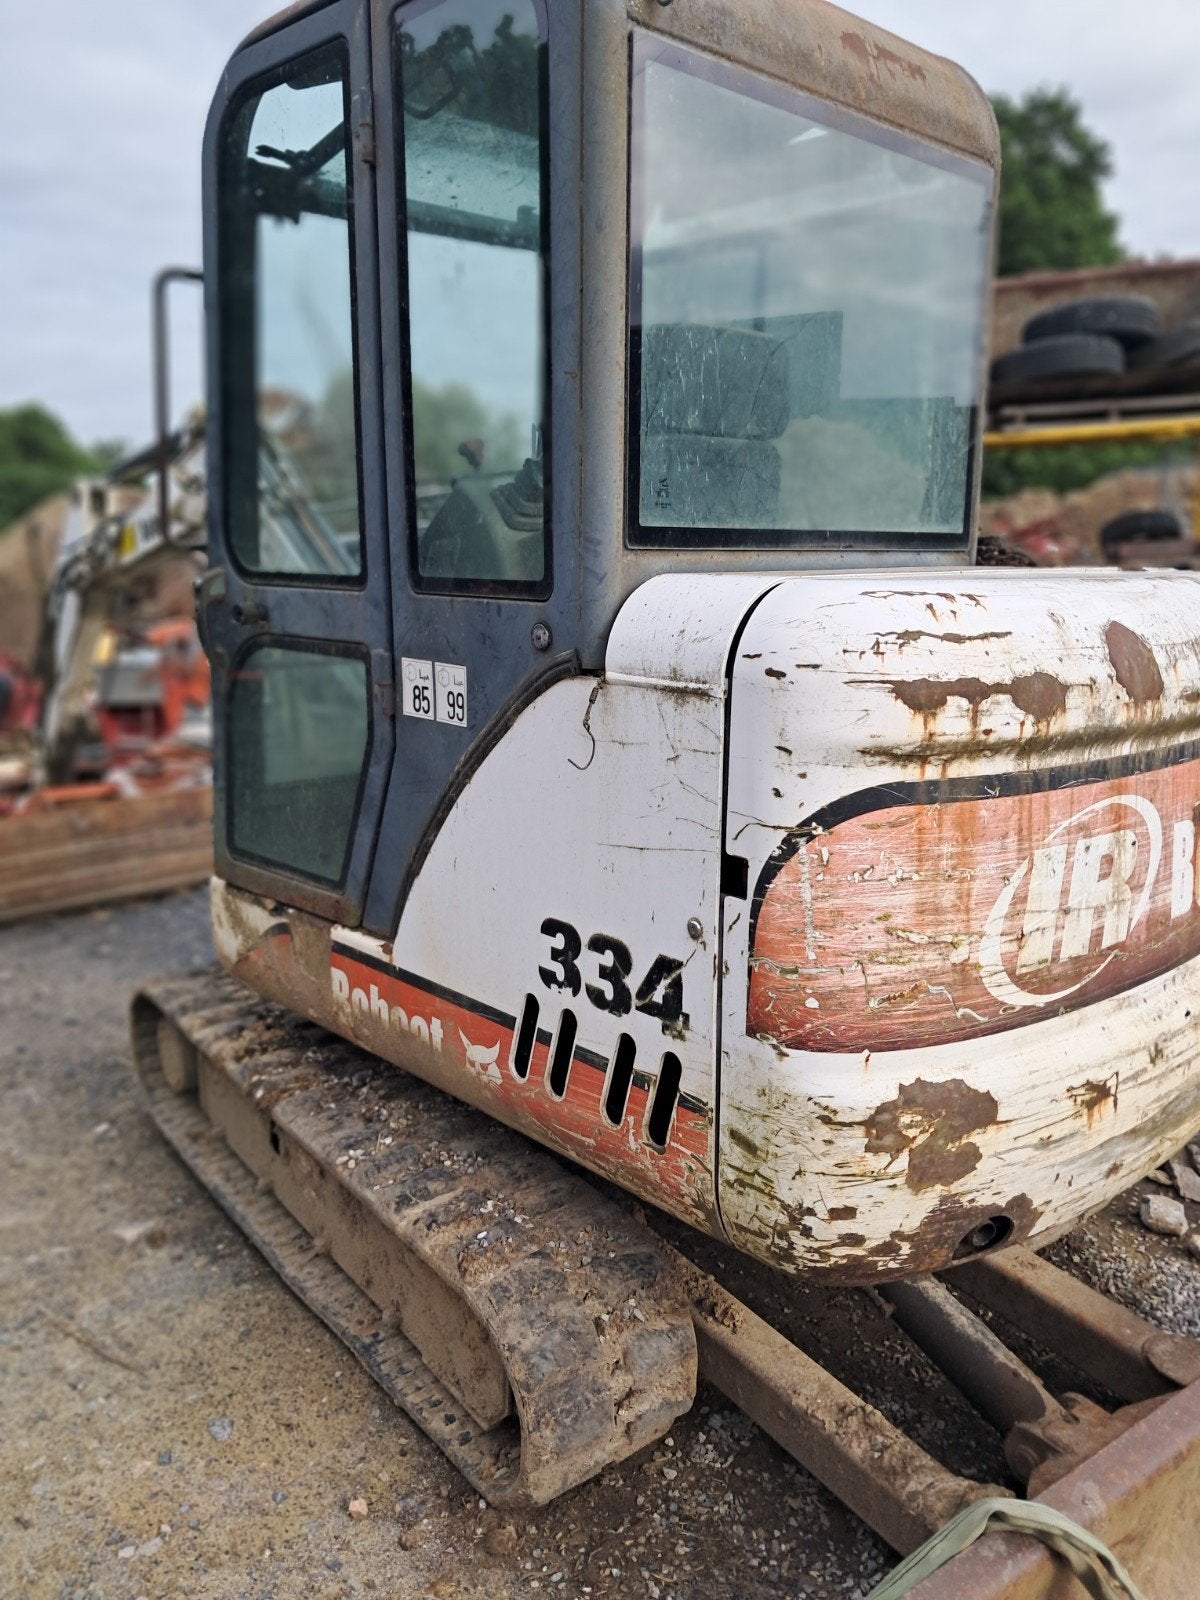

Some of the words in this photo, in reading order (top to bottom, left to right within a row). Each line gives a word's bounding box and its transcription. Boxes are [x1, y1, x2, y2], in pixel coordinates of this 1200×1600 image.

[413, 685, 430, 714] 85
[447, 691, 464, 721] 99
[538, 917, 690, 1041] 334
